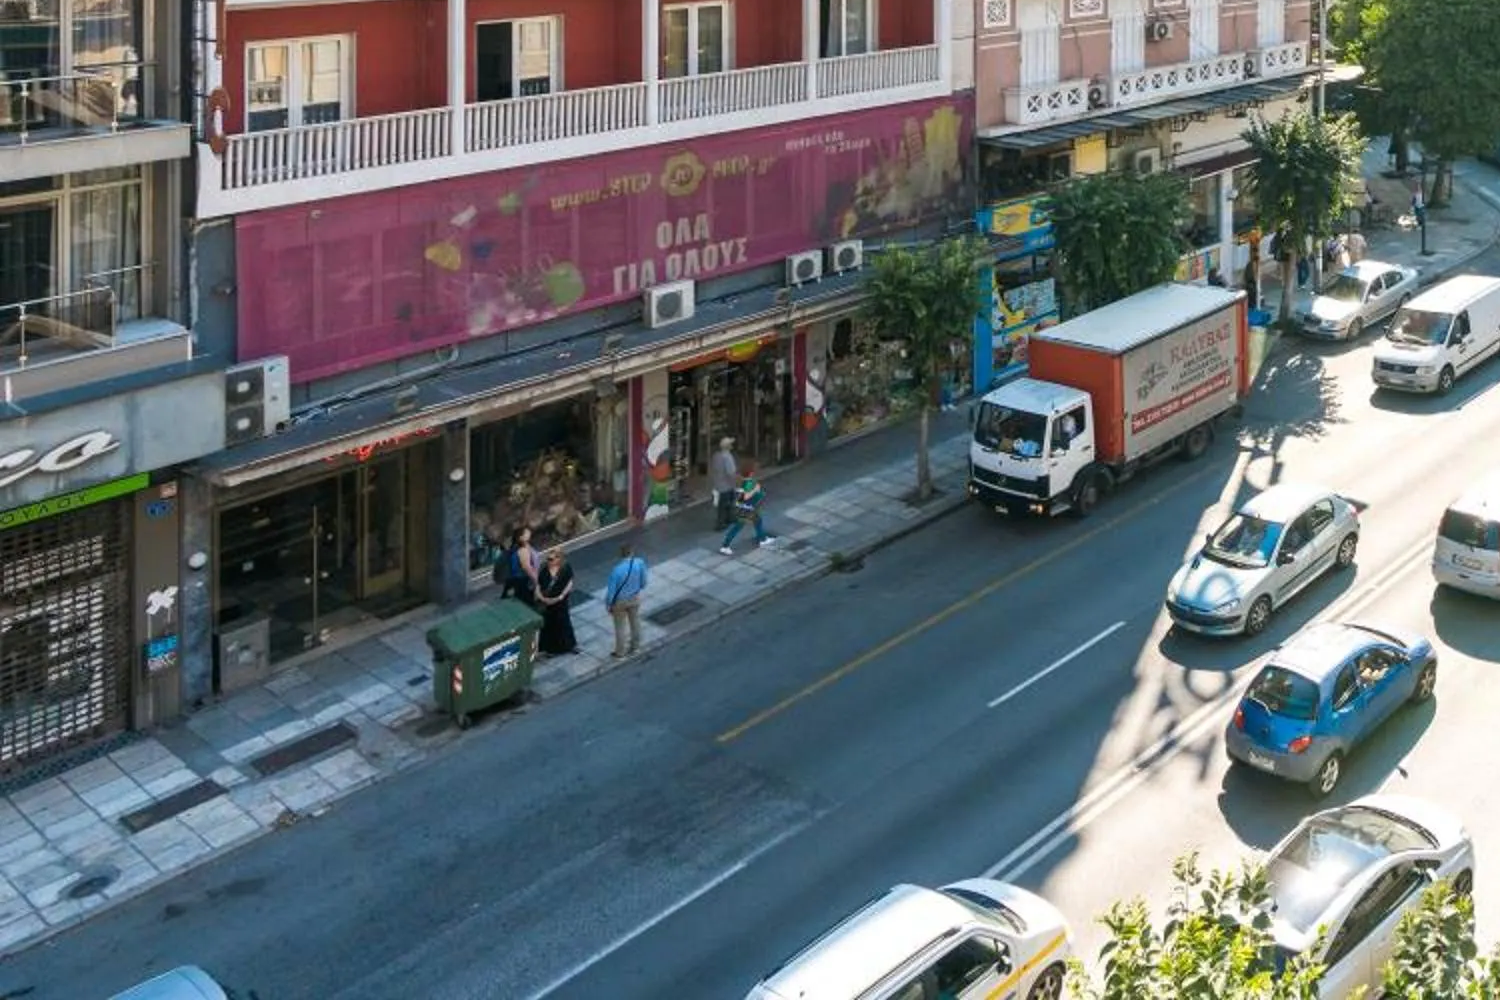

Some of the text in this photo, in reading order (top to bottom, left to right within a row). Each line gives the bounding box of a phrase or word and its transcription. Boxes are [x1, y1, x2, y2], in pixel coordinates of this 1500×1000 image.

[657, 213, 711, 250] ΟΛΑ
[613, 237, 748, 296] ΓΙΑ ΟΛΟΥΣ
